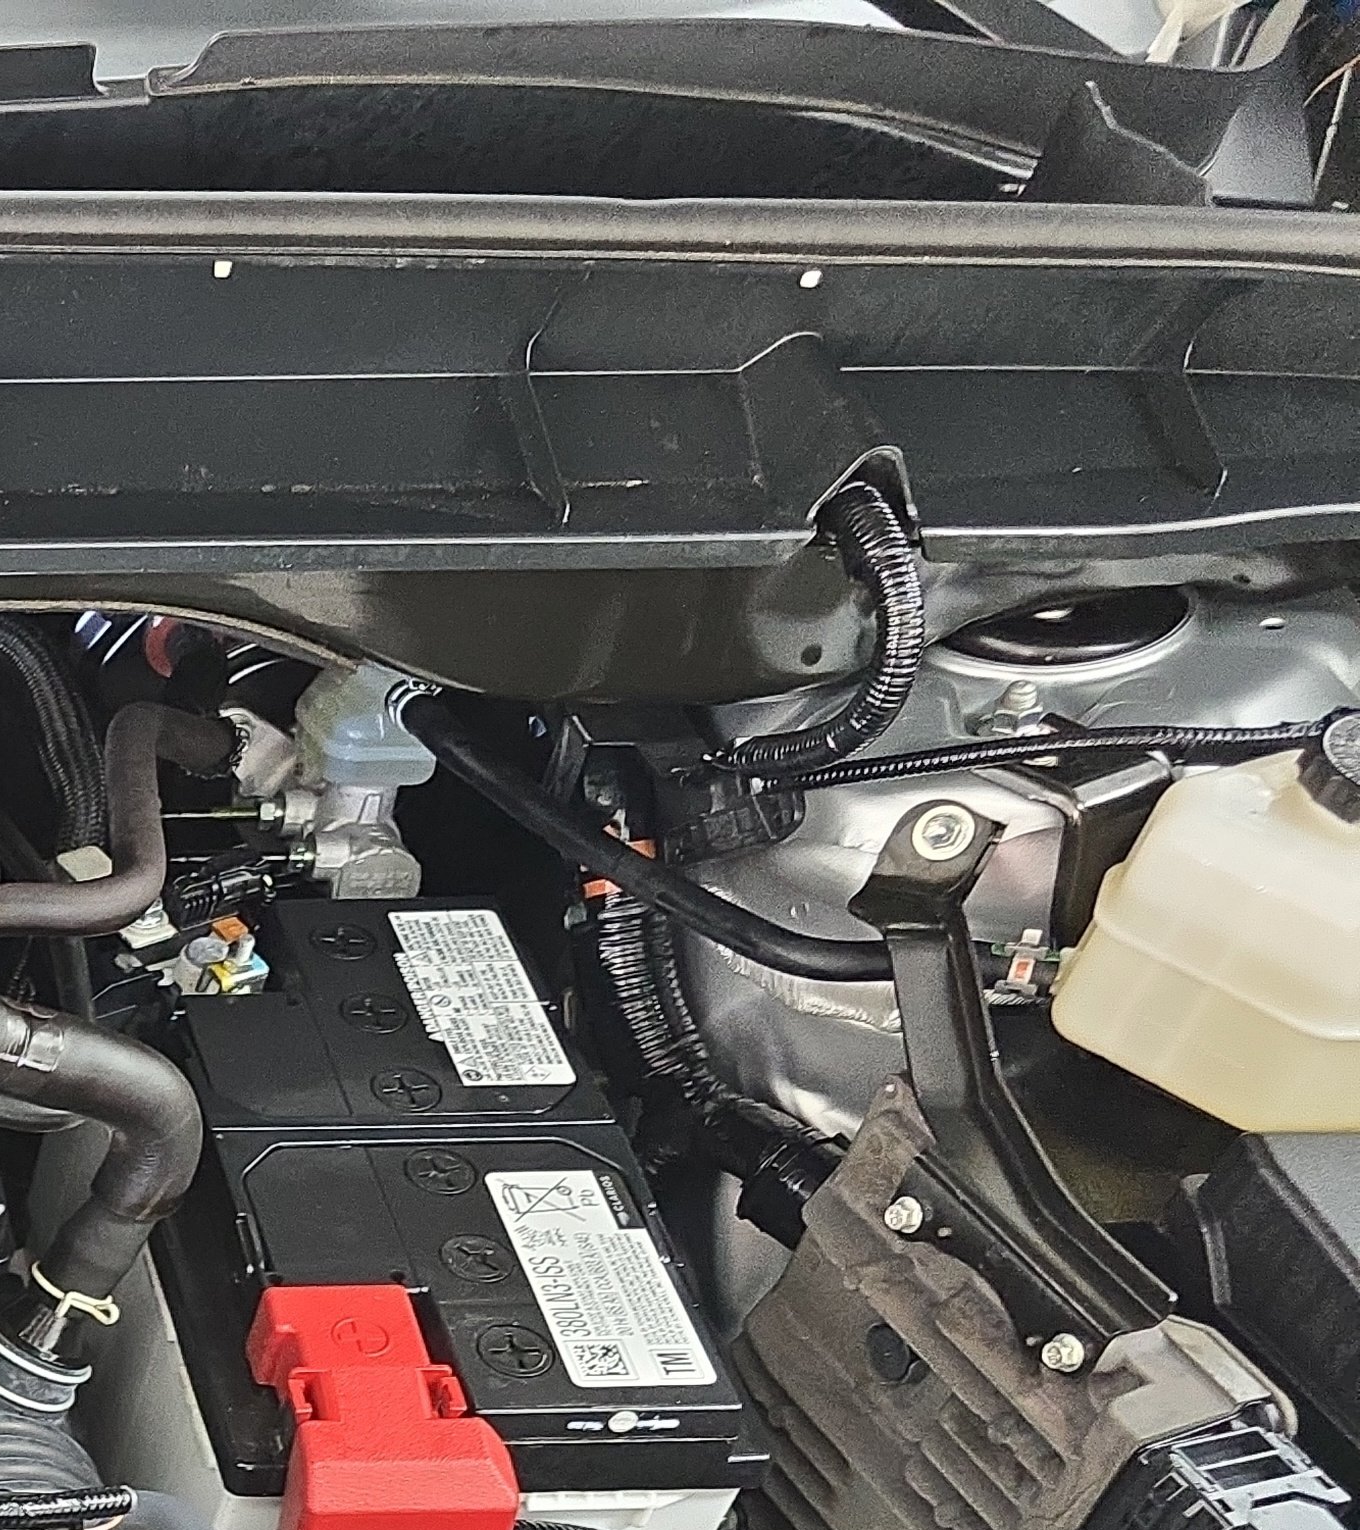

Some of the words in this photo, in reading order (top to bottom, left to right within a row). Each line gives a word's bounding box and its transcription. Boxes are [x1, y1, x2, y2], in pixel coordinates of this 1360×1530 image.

[580, 1188, 601, 1209] Pb
[599, 1175, 624, 1213] CLARIOS
[528, 1255, 591, 1338] 380LN3-ISS
[656, 1351, 696, 1376] TM
